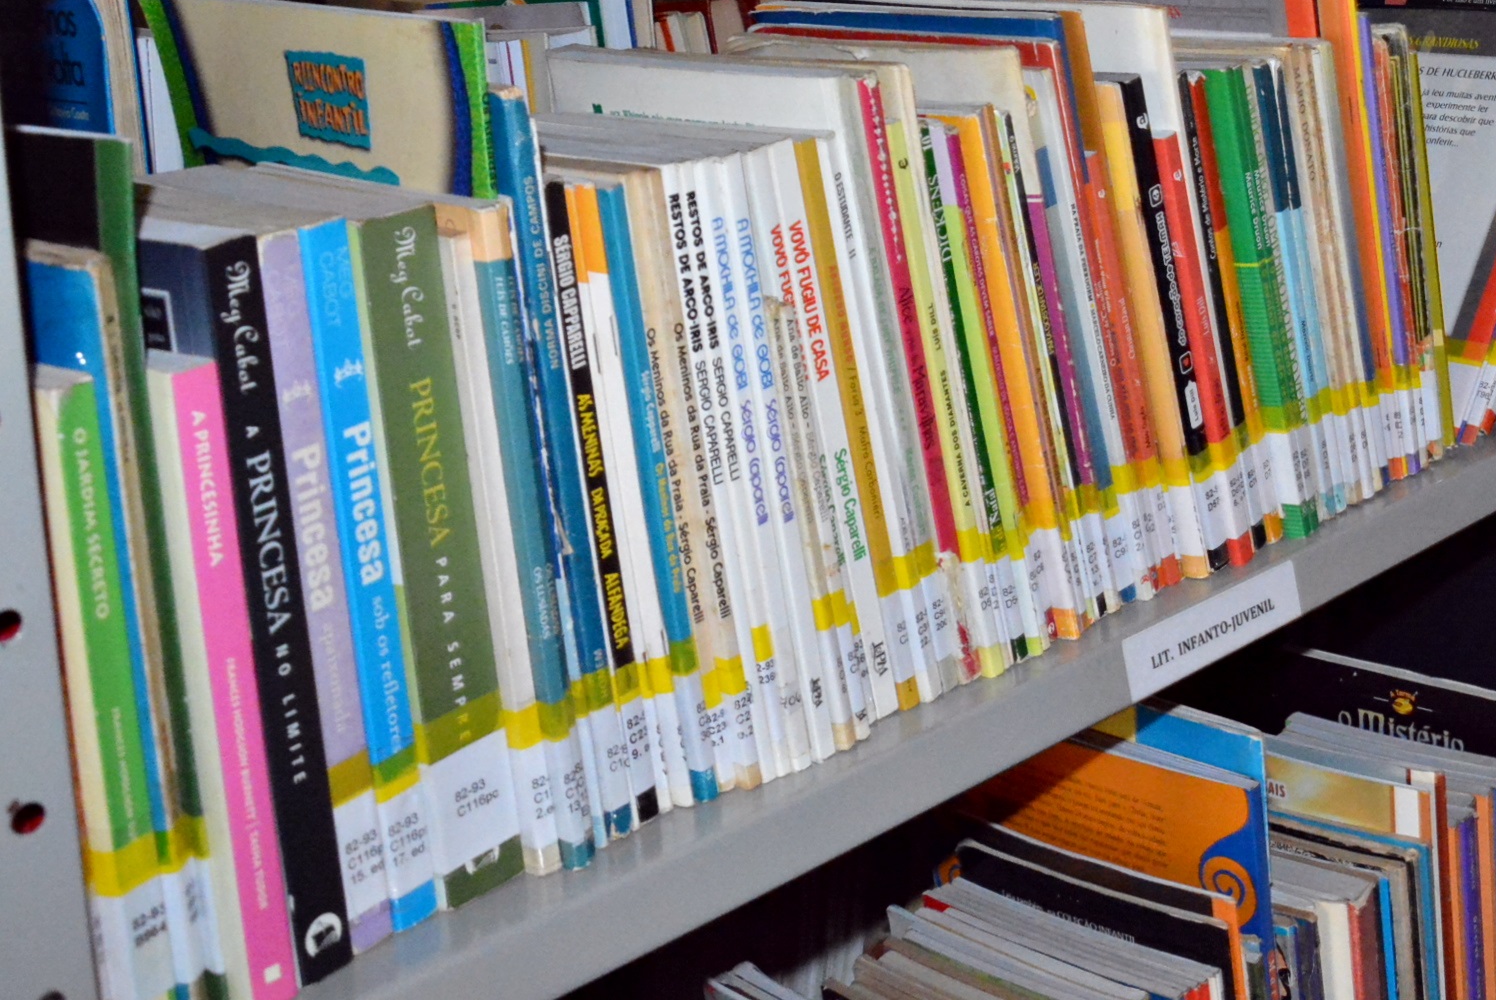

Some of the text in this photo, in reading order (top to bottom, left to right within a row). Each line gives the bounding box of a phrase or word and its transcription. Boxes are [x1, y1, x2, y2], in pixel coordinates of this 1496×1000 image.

[1426, 67, 1440, 76] DE
[1432, 90, 1445, 98] leu
[1446, 91, 1472, 99] muitas
[298, 91, 369, 136] INFANTIL
[1424, 125, 1476, 137] histórias que
[1426, 101, 1489, 113] experimente ler
[1439, 113, 1495, 127] descobrir que
[1301, 122, 1317, 182] DONATO
[711, 216, 724, 231] A
[836, 183, 854, 241] ESTUDANTE
[928, 177, 952, 264] DICKENS
[553, 232, 575, 288] SÉRGIO
[714, 234, 738, 311] MOCHILA
[563, 288, 588, 370] CAPPARELLI
[726, 313, 740, 340] de
[789, 219, 831, 383] VOVÔ FUGIU DE CASA
[685, 190, 741, 483] RESTOS DE ARCO-IRIS SERGIO CAPARELLI
[731, 343, 749, 392] GOBI
[577, 393, 593, 411] AS
[580, 411, 604, 479] MENINAS
[673, 322, 732, 620] Os Meninos da Rua da Praia Sérgio Caparelli
[191, 410, 225, 569] A PRINCESINHA
[390, 225, 472, 742] Meg Cabot PRINCESA PARA SEMPRE
[749, 456, 770, 527] Caparelli
[834, 448, 867, 562] Sérgio Caparelli
[72, 427, 110, 620] O JARDIM SECRETO
[219, 259, 307, 785] Meg Cabot A PRINCESA NO LIMITE
[291, 443, 335, 613] Princesa
[343, 420, 391, 657] Princesa sob os
[604, 572, 631, 650] ALFANDEGA
[1151, 597, 1275, 671] LIT. INFANTO-JUVENIL
[454, 778, 487, 803] 82-93
[456, 789, 500, 819] C116pc
